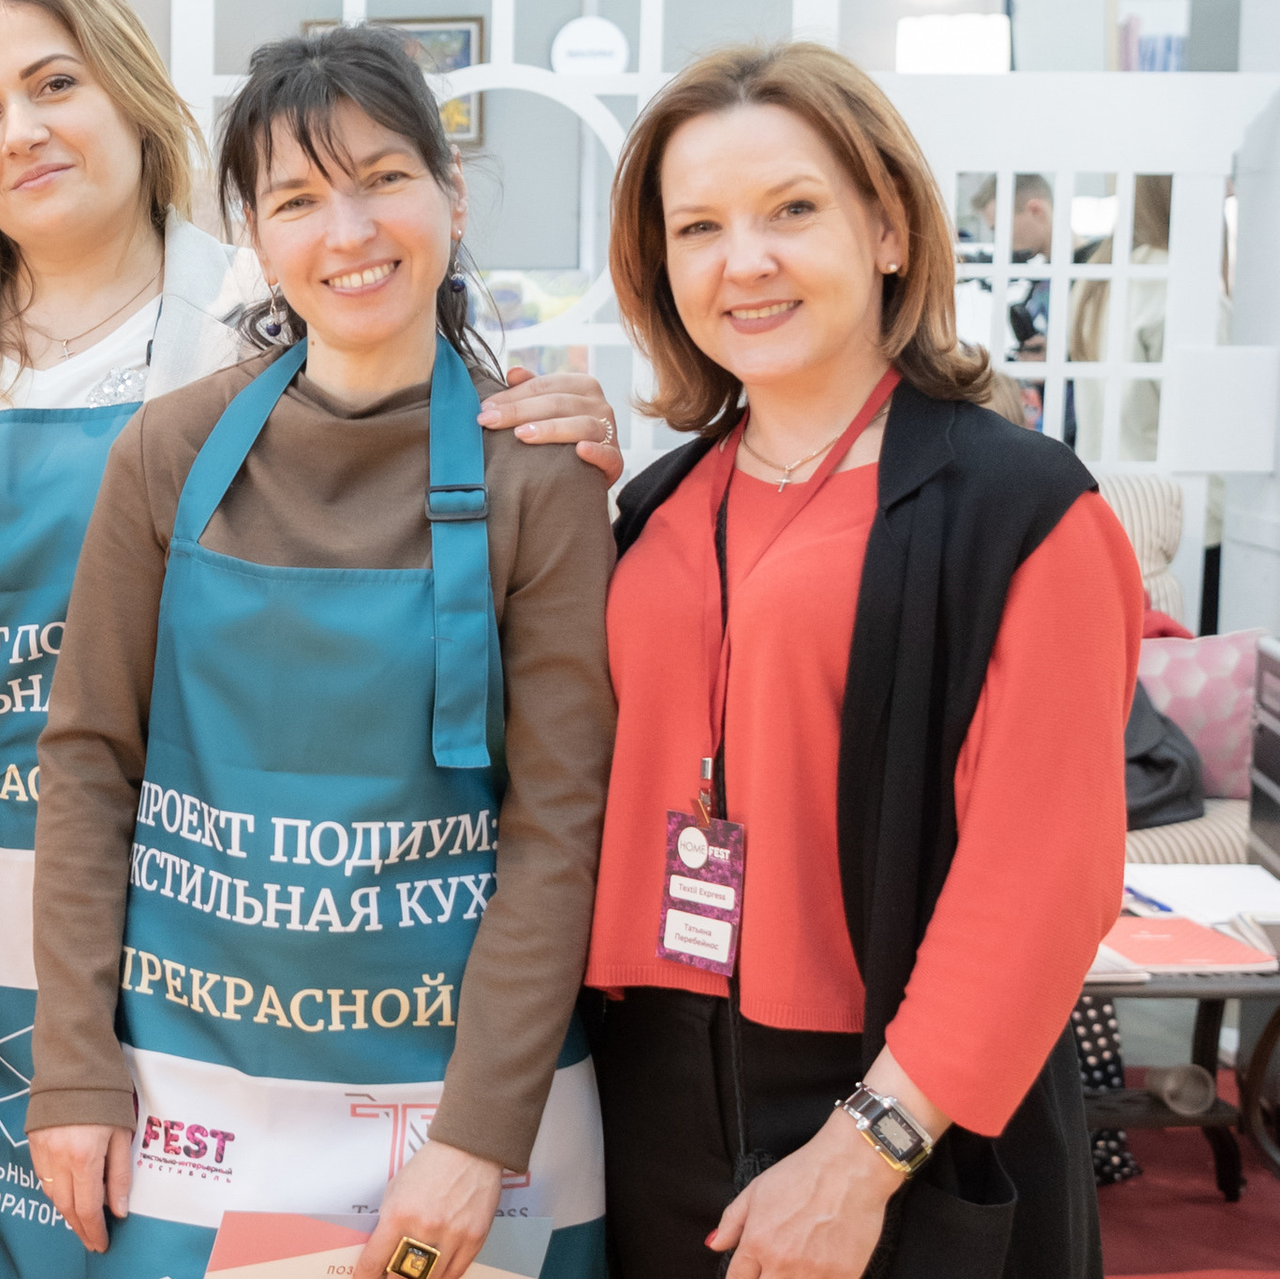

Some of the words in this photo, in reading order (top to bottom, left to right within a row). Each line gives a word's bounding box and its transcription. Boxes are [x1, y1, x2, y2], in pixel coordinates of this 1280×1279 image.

[137, 780, 255, 858] ПРОЕКТ
[708, 845, 731, 860] FEST
[130, 843, 382, 933] КСТИЛЬНАЯ
[679, 883, 697, 894] Textil
[699, 887, 726, 901] Express
[684, 922, 712, 936] Татьяна
[142, 1115, 235, 1163] FEST
